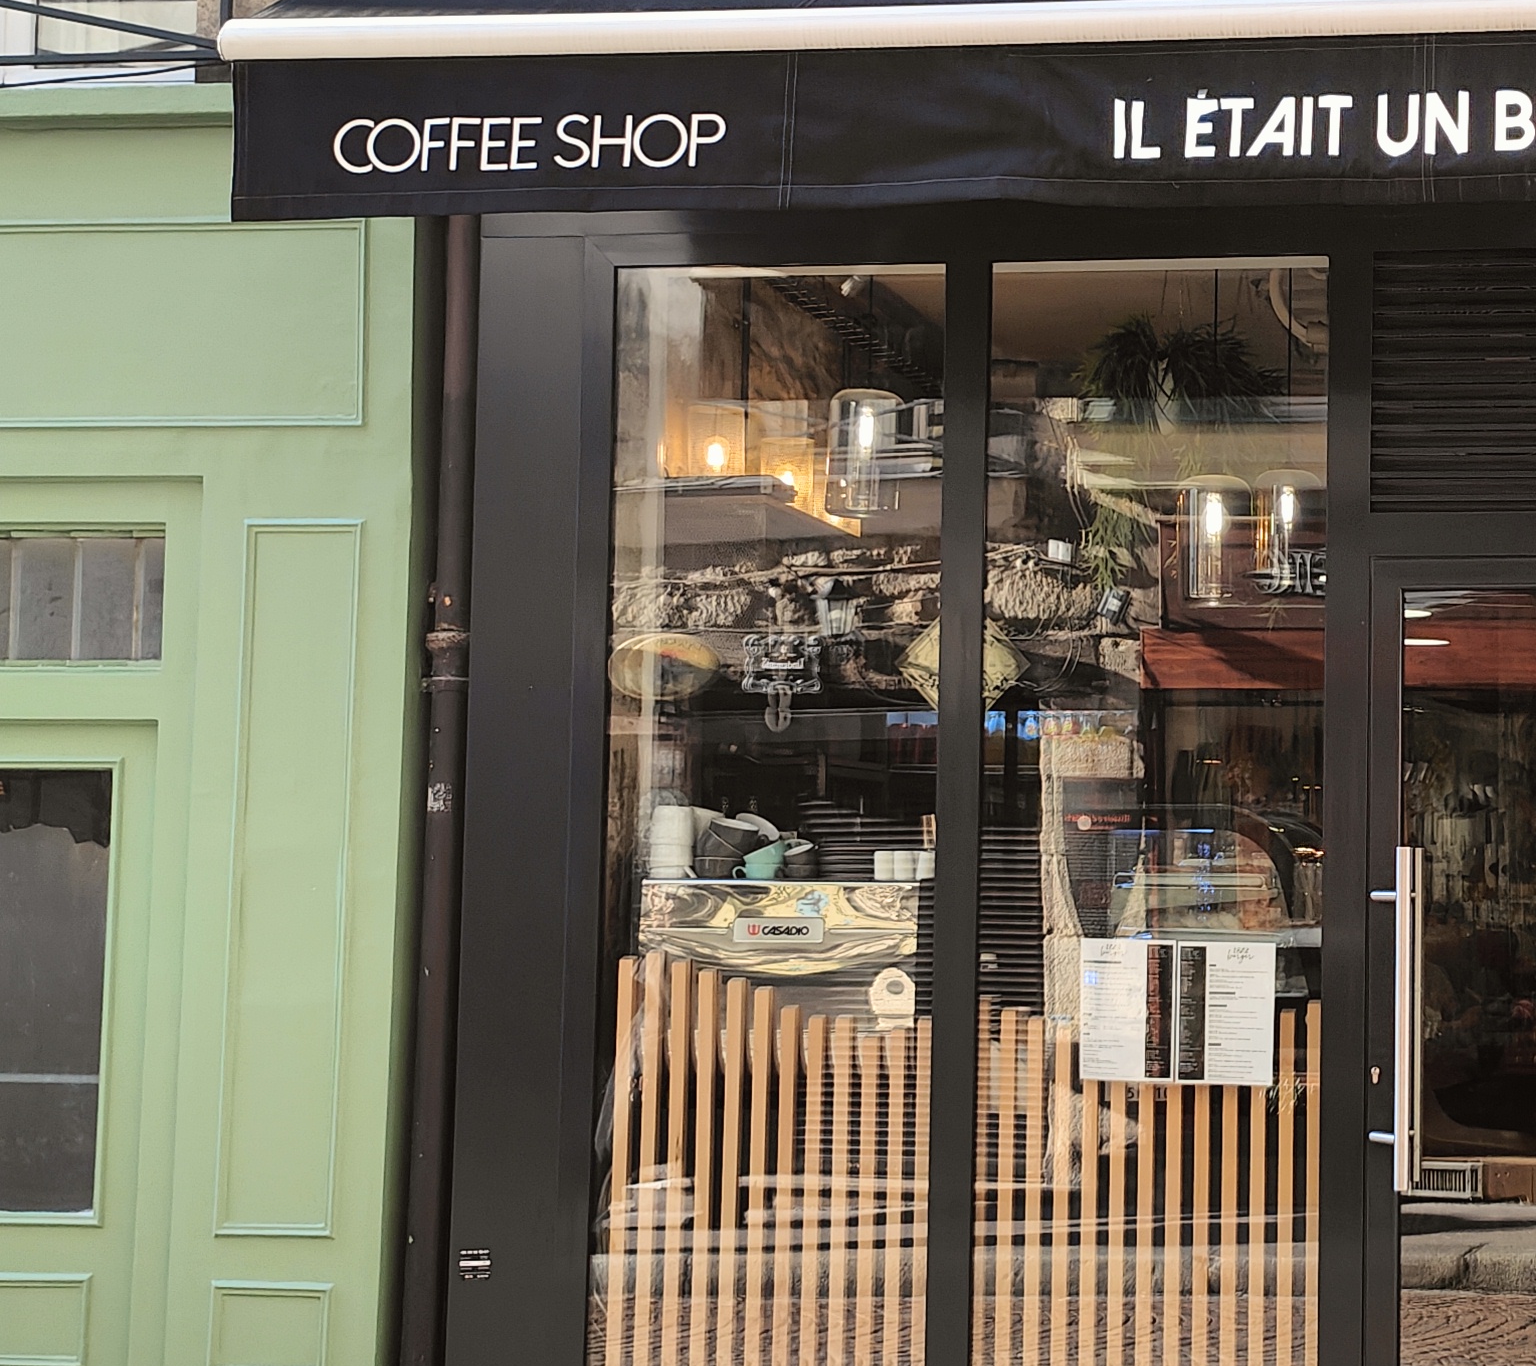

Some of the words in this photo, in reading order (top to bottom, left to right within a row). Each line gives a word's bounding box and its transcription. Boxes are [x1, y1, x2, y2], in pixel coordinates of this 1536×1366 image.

[333, 116, 543, 174] COFFEE
[553, 113, 727, 169] SHOP
[1113, 97, 1161, 159] IL
[1184, 89, 1353, 159] ÉTAIT
[1376, 89, 1470, 157] UN
[761, 925, 810, 936] CASADIO
